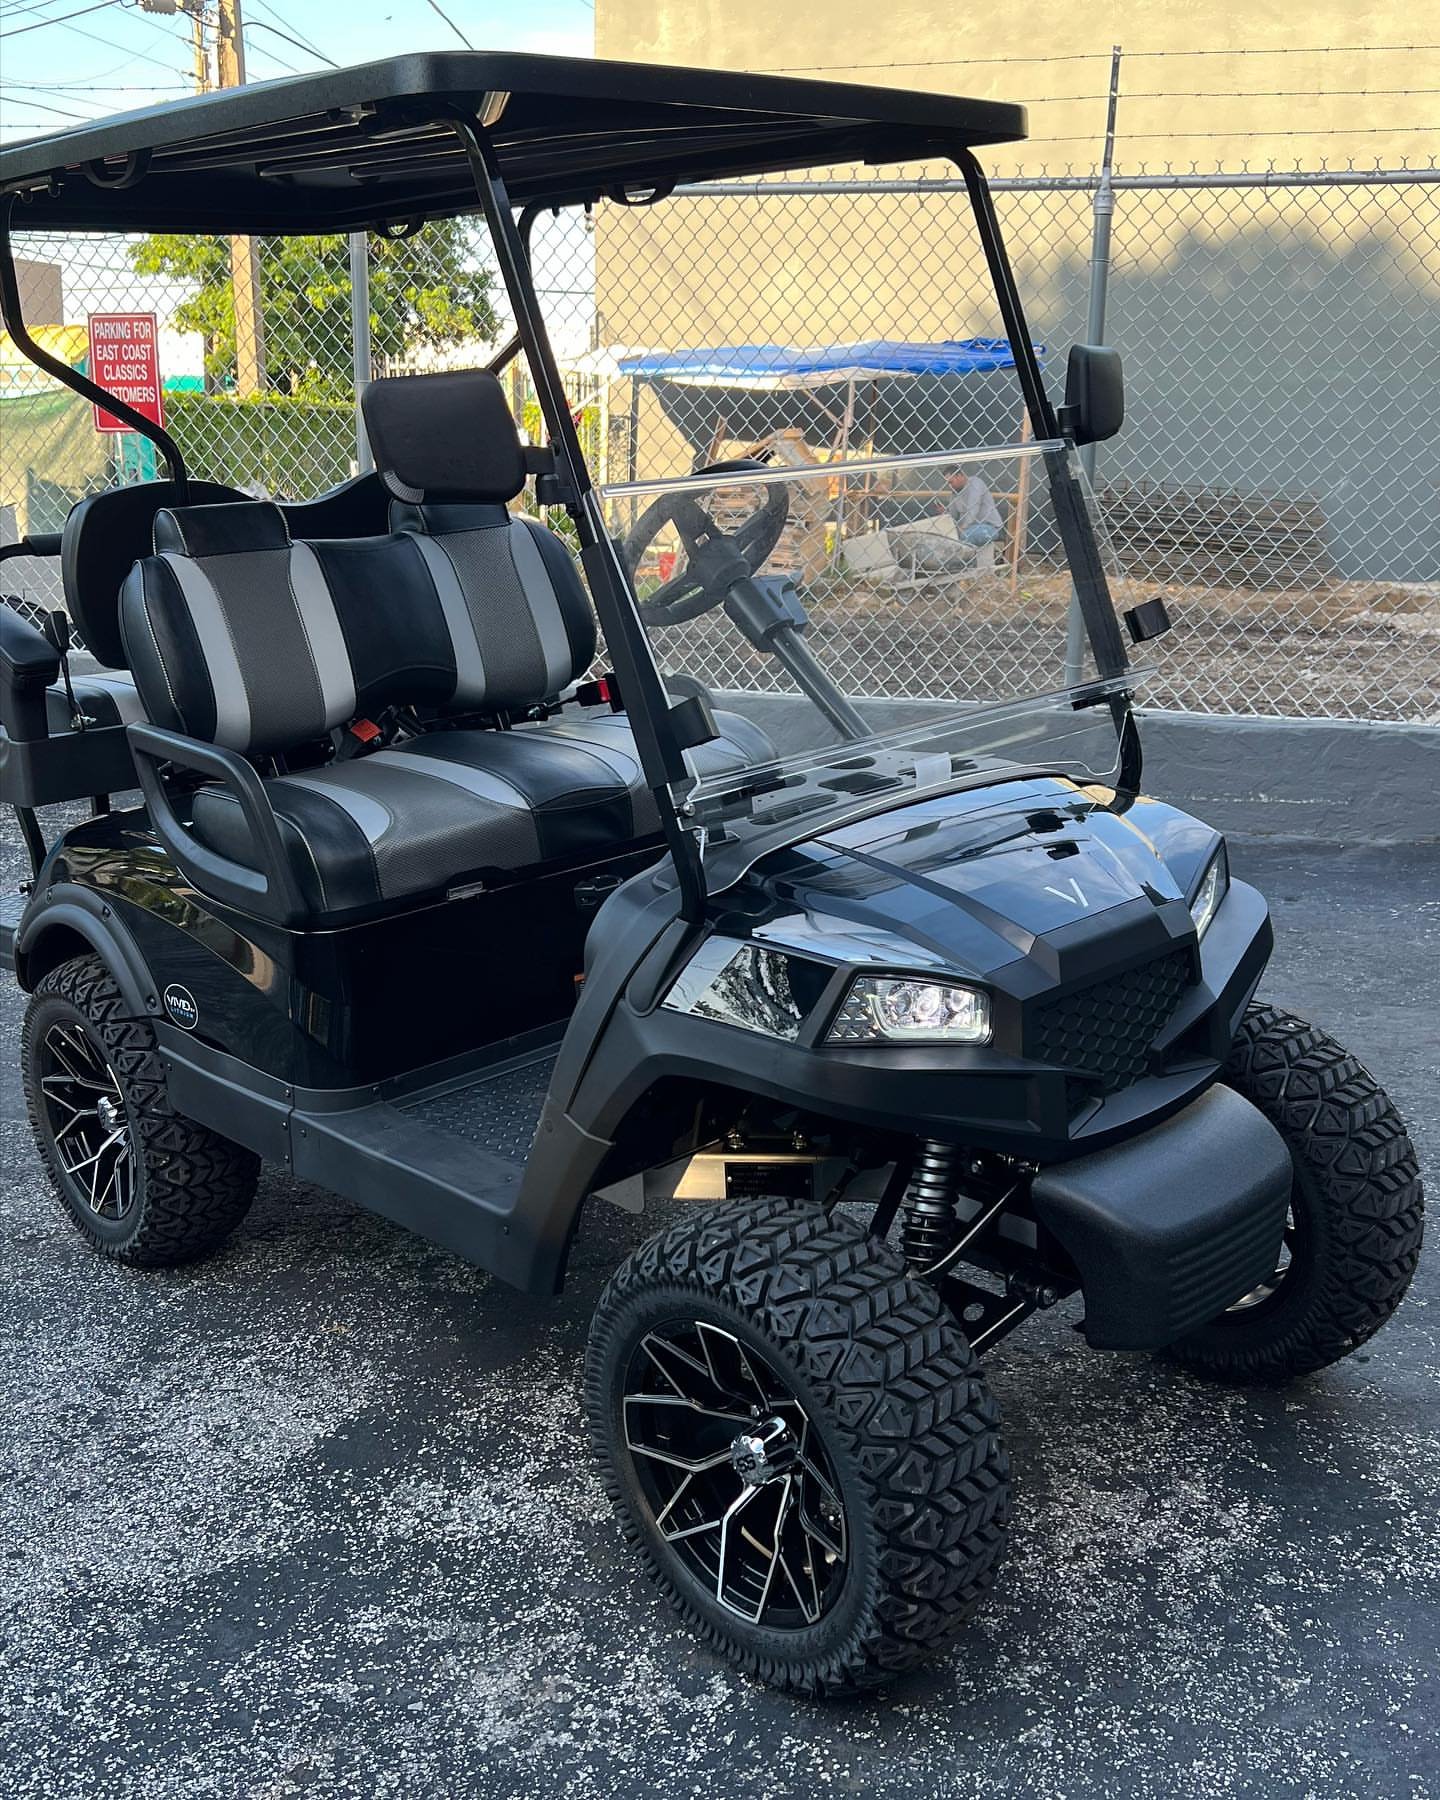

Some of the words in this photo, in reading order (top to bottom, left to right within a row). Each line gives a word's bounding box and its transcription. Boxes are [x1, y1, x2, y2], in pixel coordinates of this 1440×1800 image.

[94, 322, 130, 339] PARKING
[133, 322, 152, 339] FOR
[96, 345, 119, 361] EAST
[121, 344, 152, 361] COAST
[103, 364, 148, 380] CLASSICS
[100, 386, 155, 403] STOMERS
